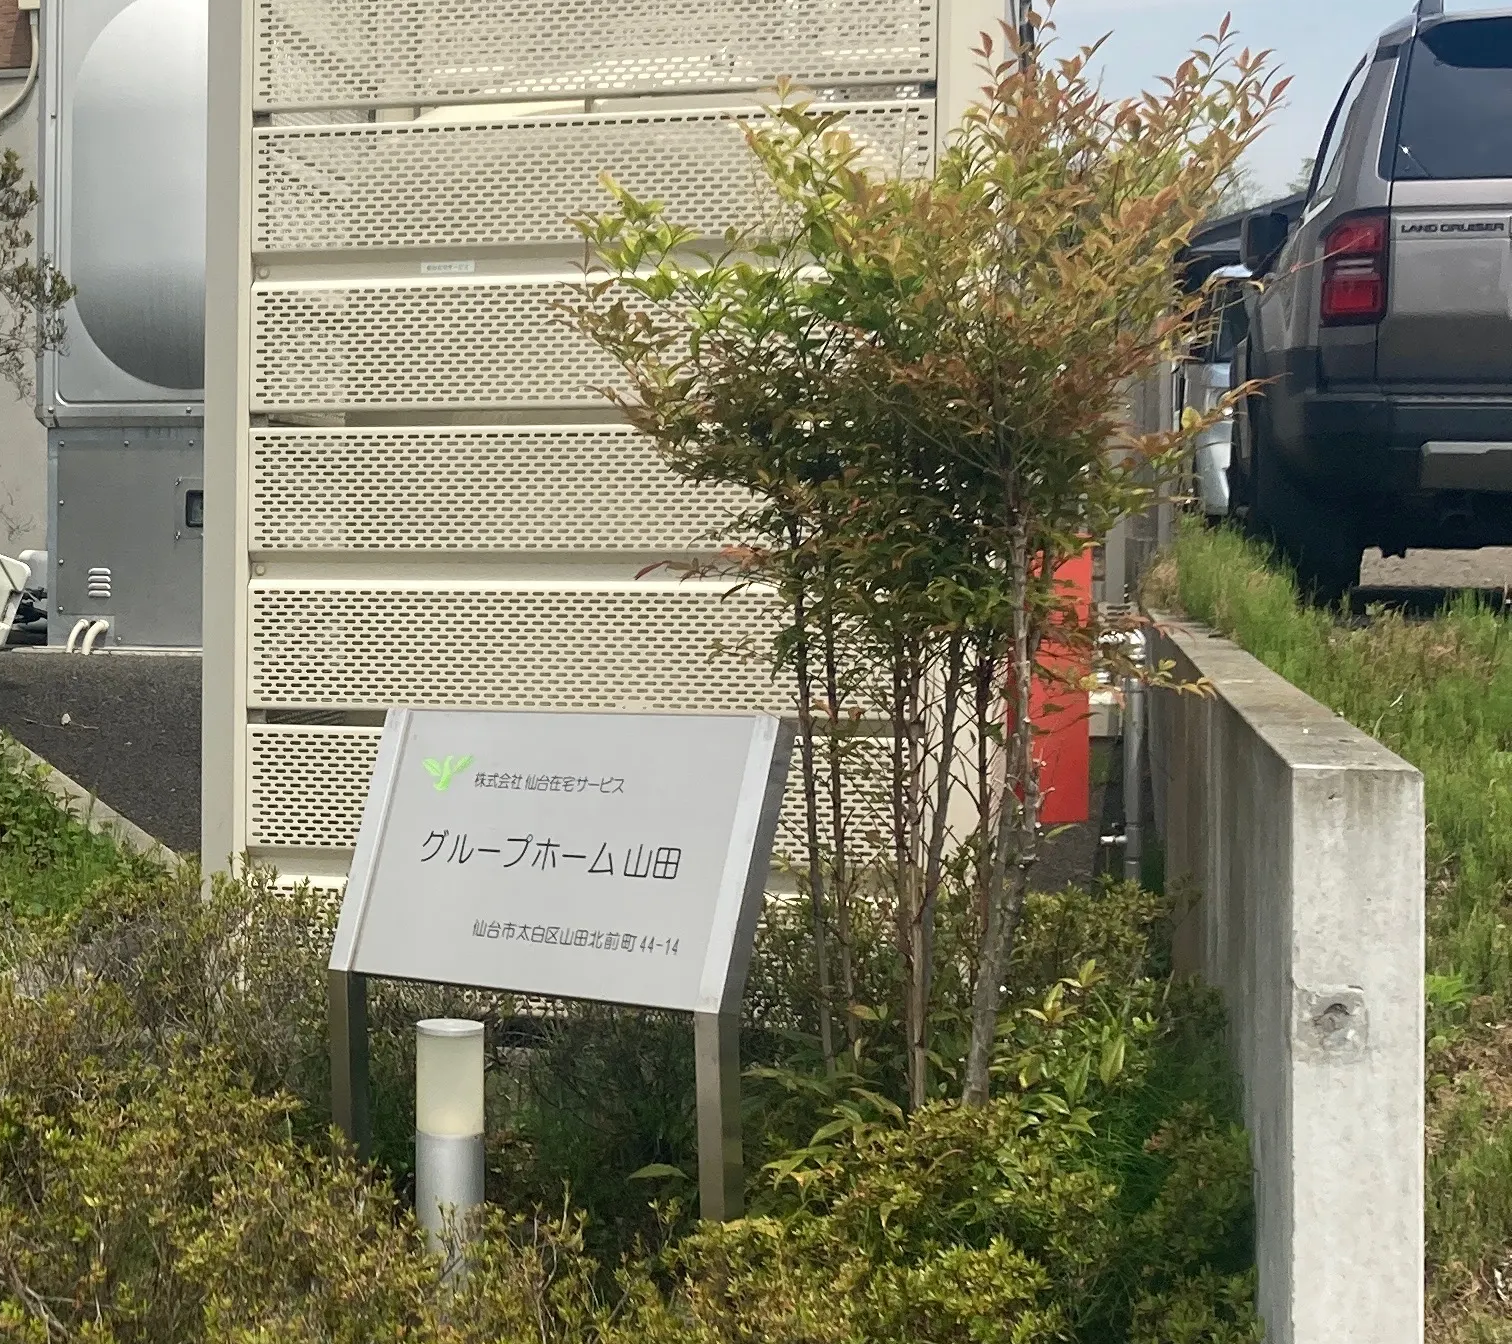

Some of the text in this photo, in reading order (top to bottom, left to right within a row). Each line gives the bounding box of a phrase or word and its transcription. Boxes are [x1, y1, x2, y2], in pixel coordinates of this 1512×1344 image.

[1401, 222, 1505, 233] LAND CRUISER
[474, 772, 625, 794] 株式会社 仙台在宅サービス
